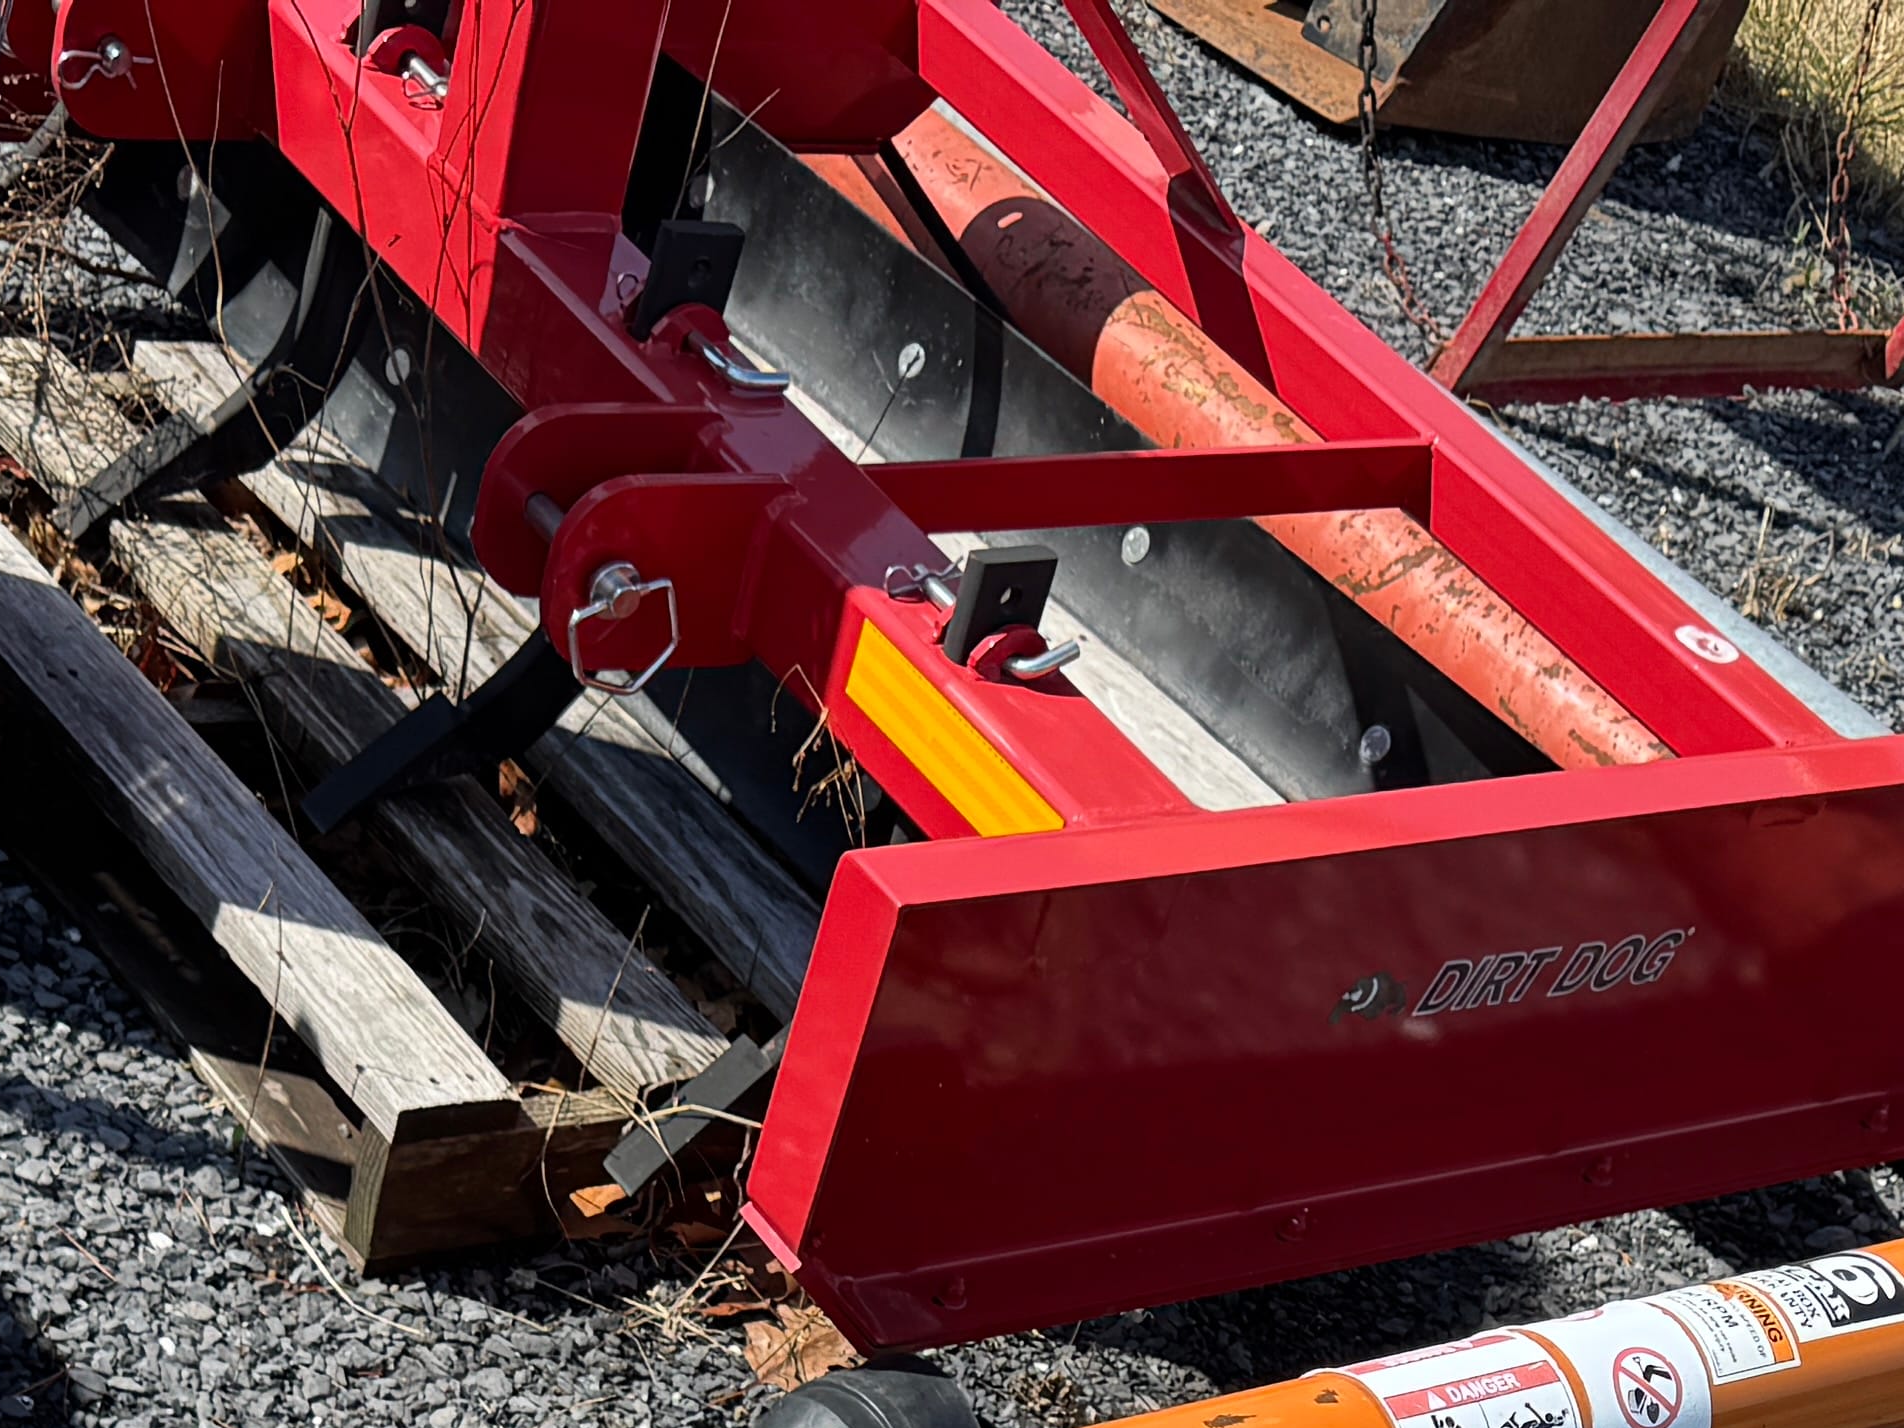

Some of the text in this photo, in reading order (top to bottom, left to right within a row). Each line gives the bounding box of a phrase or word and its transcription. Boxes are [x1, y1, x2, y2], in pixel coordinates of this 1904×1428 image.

[1412, 929, 1686, 1017] DIRT DOG
[1446, 1371, 1519, 1403] DANGER
